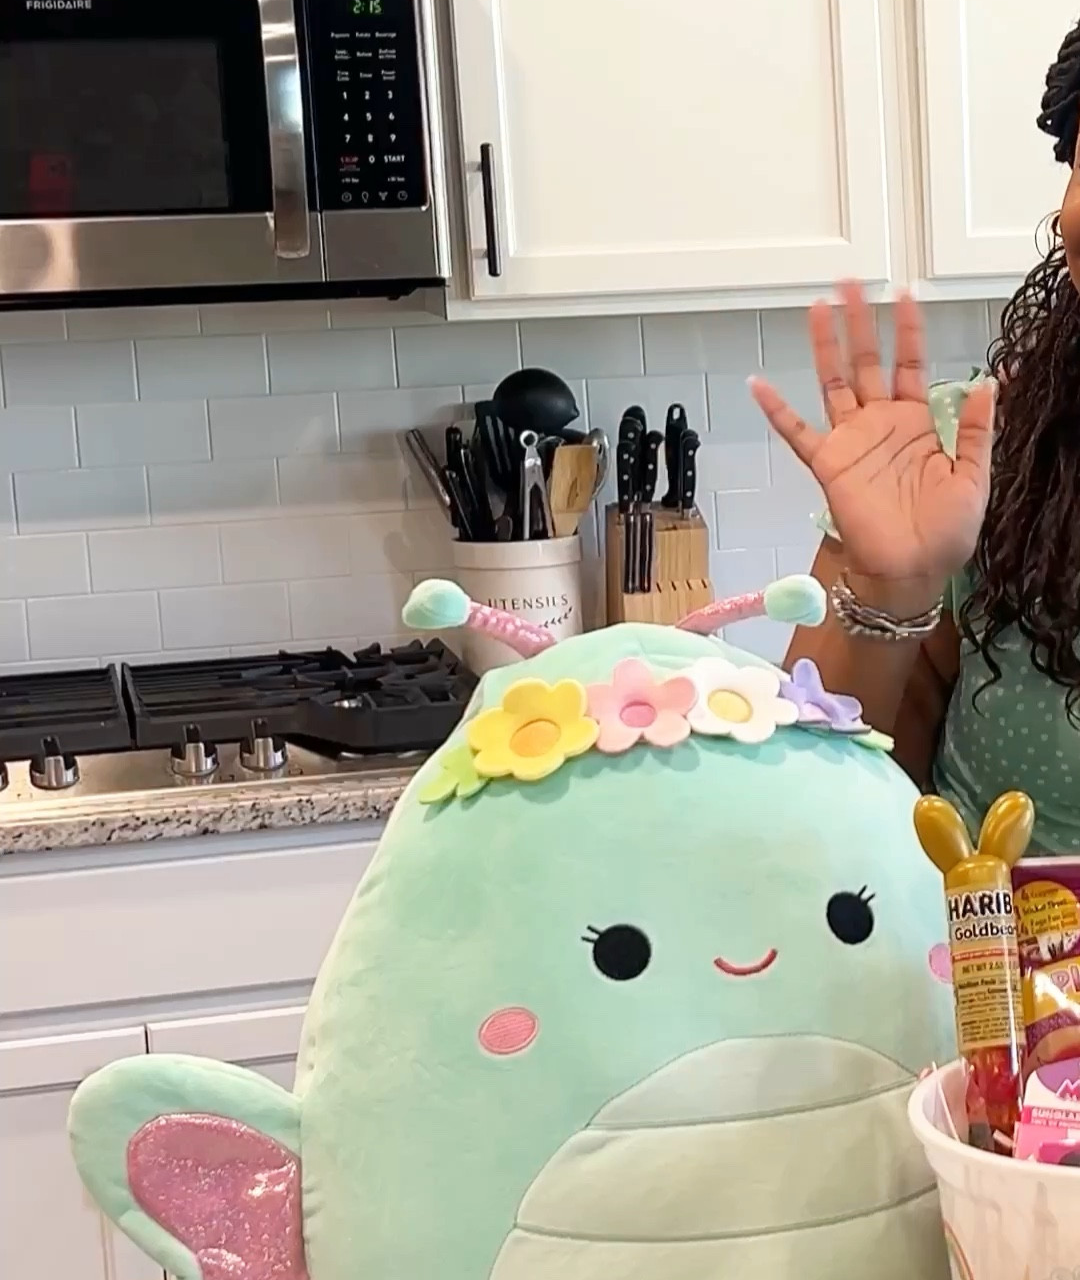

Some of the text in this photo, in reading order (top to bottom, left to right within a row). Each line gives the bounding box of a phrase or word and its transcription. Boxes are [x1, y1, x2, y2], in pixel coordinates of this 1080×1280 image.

[25, 0, 92, 11] FRIGIDAIRE
[353, 0, 382, 14] 2:15
[342, 91, 347, 100] 1
[364, 90, 370, 100] 2
[387, 90, 393, 100] 3
[343, 113, 349, 121] 4
[366, 112, 372, 121] 5
[388, 112, 395, 120] 6
[345, 134, 351, 143] 7
[367, 133, 374, 143] 8
[390, 133, 396, 143] 9
[368, 154, 376, 164] 0
[383, 155, 405, 163] START
